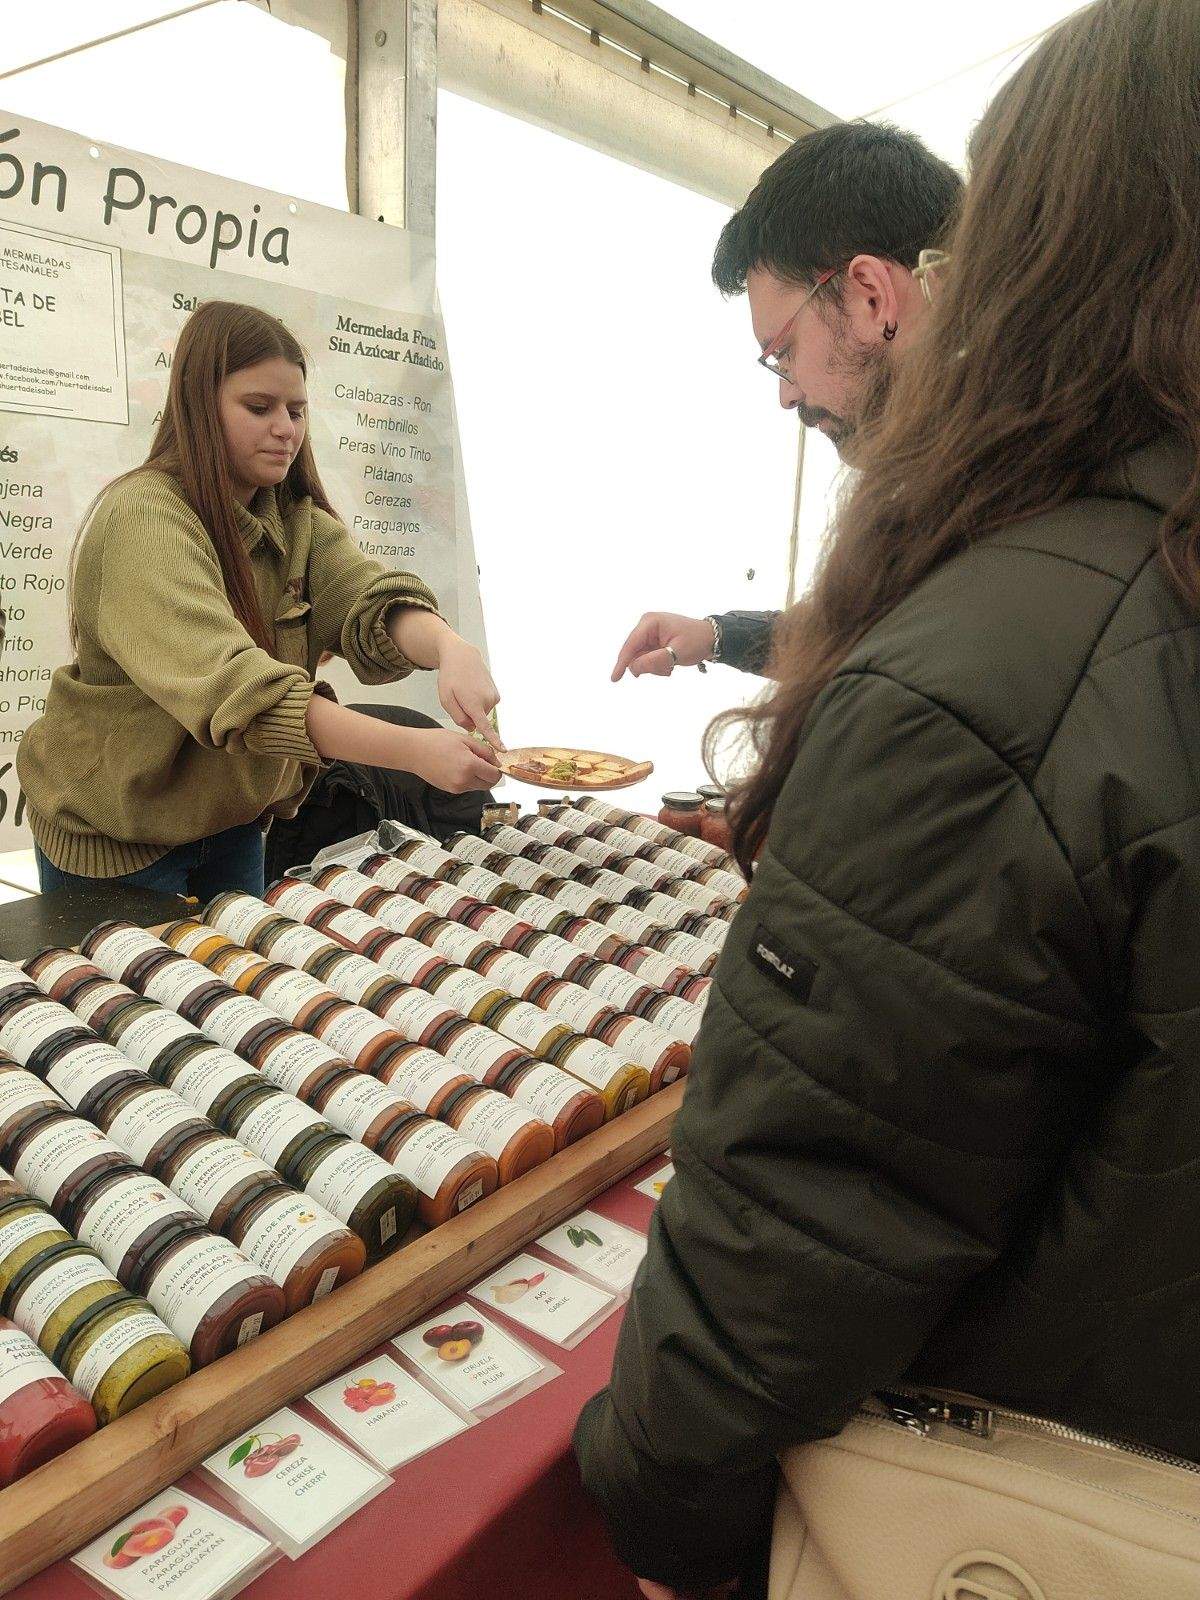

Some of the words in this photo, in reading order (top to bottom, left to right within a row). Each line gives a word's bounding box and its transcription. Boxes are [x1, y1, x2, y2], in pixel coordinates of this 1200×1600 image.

[103, 167, 290, 269] Propia
[3, 248, 72, 270] MERMELADAS
[33, 293, 56, 312] DE
[335, 314, 410, 343] Mermelada
[328, 335, 351, 354] Sin
[354, 341, 400, 361] Azúcar
[402, 349, 444, 372] Añadido
[334, 383, 405, 407] Calabazas
[413, 396, 432, 413] Ron
[356, 413, 420, 435] Membrillos
[338, 436, 376, 454] Peras
[380, 441, 406, 458] Vino
[409, 446, 432, 462] Tinto
[363, 465, 414, 484] Plátanos
[364, 491, 412, 508] Cerezas
[353, 515, 421, 535] Paraguayos
[0, 542, 53, 560] Verde
[358, 541, 416, 557] Manzanas
[23, 574, 66, 594] Rojo
[125, 1114, 135, 1126] LA
[242, 1121, 260, 1146] UERTA
[260, 1110, 270, 1120] DE
[24, 1161, 33, 1173] LA
[32, 1132, 61, 1162] HUERTA
[38, 1134, 84, 1169] MERMELADA
[182, 1156, 210, 1186] HUERTA
[194, 1153, 237, 1187] MERMELADA
[93, 1200, 120, 1233] HUERTA
[121, 1190, 134, 1200] DE
[102, 1197, 144, 1238] MERMELADA
[266, 1221, 278, 1233] DE
[277, 1202, 304, 1222] ISABEL
[106, 1231, 116, 1242] DE
[161, 1285, 172, 1297] LA
[170, 1252, 206, 1283] HUERTA
[206, 1244, 218, 1254] DE
[180, 1254, 229, 1291] MERMELADA
[185, 1285, 196, 1296] DE
[194, 1259, 233, 1286] CIRUELAS
[105, 1325, 137, 1350] OLIVADA
[462, 1355, 494, 1375] CIRUELA
[482, 1371, 506, 1387] PLUM
[366, 1399, 409, 1427] HABANERO
[276, 1457, 308, 1480] CEREZA
[287, 1465, 317, 1487] CERISE
[295, 1470, 328, 1497] CHERRY
[142, 1528, 202, 1575] PARAGUAYO
[149, 1532, 215, 1583] PARAGUAYEN
[158, 1537, 226, 1591] PARAGUAYAN
